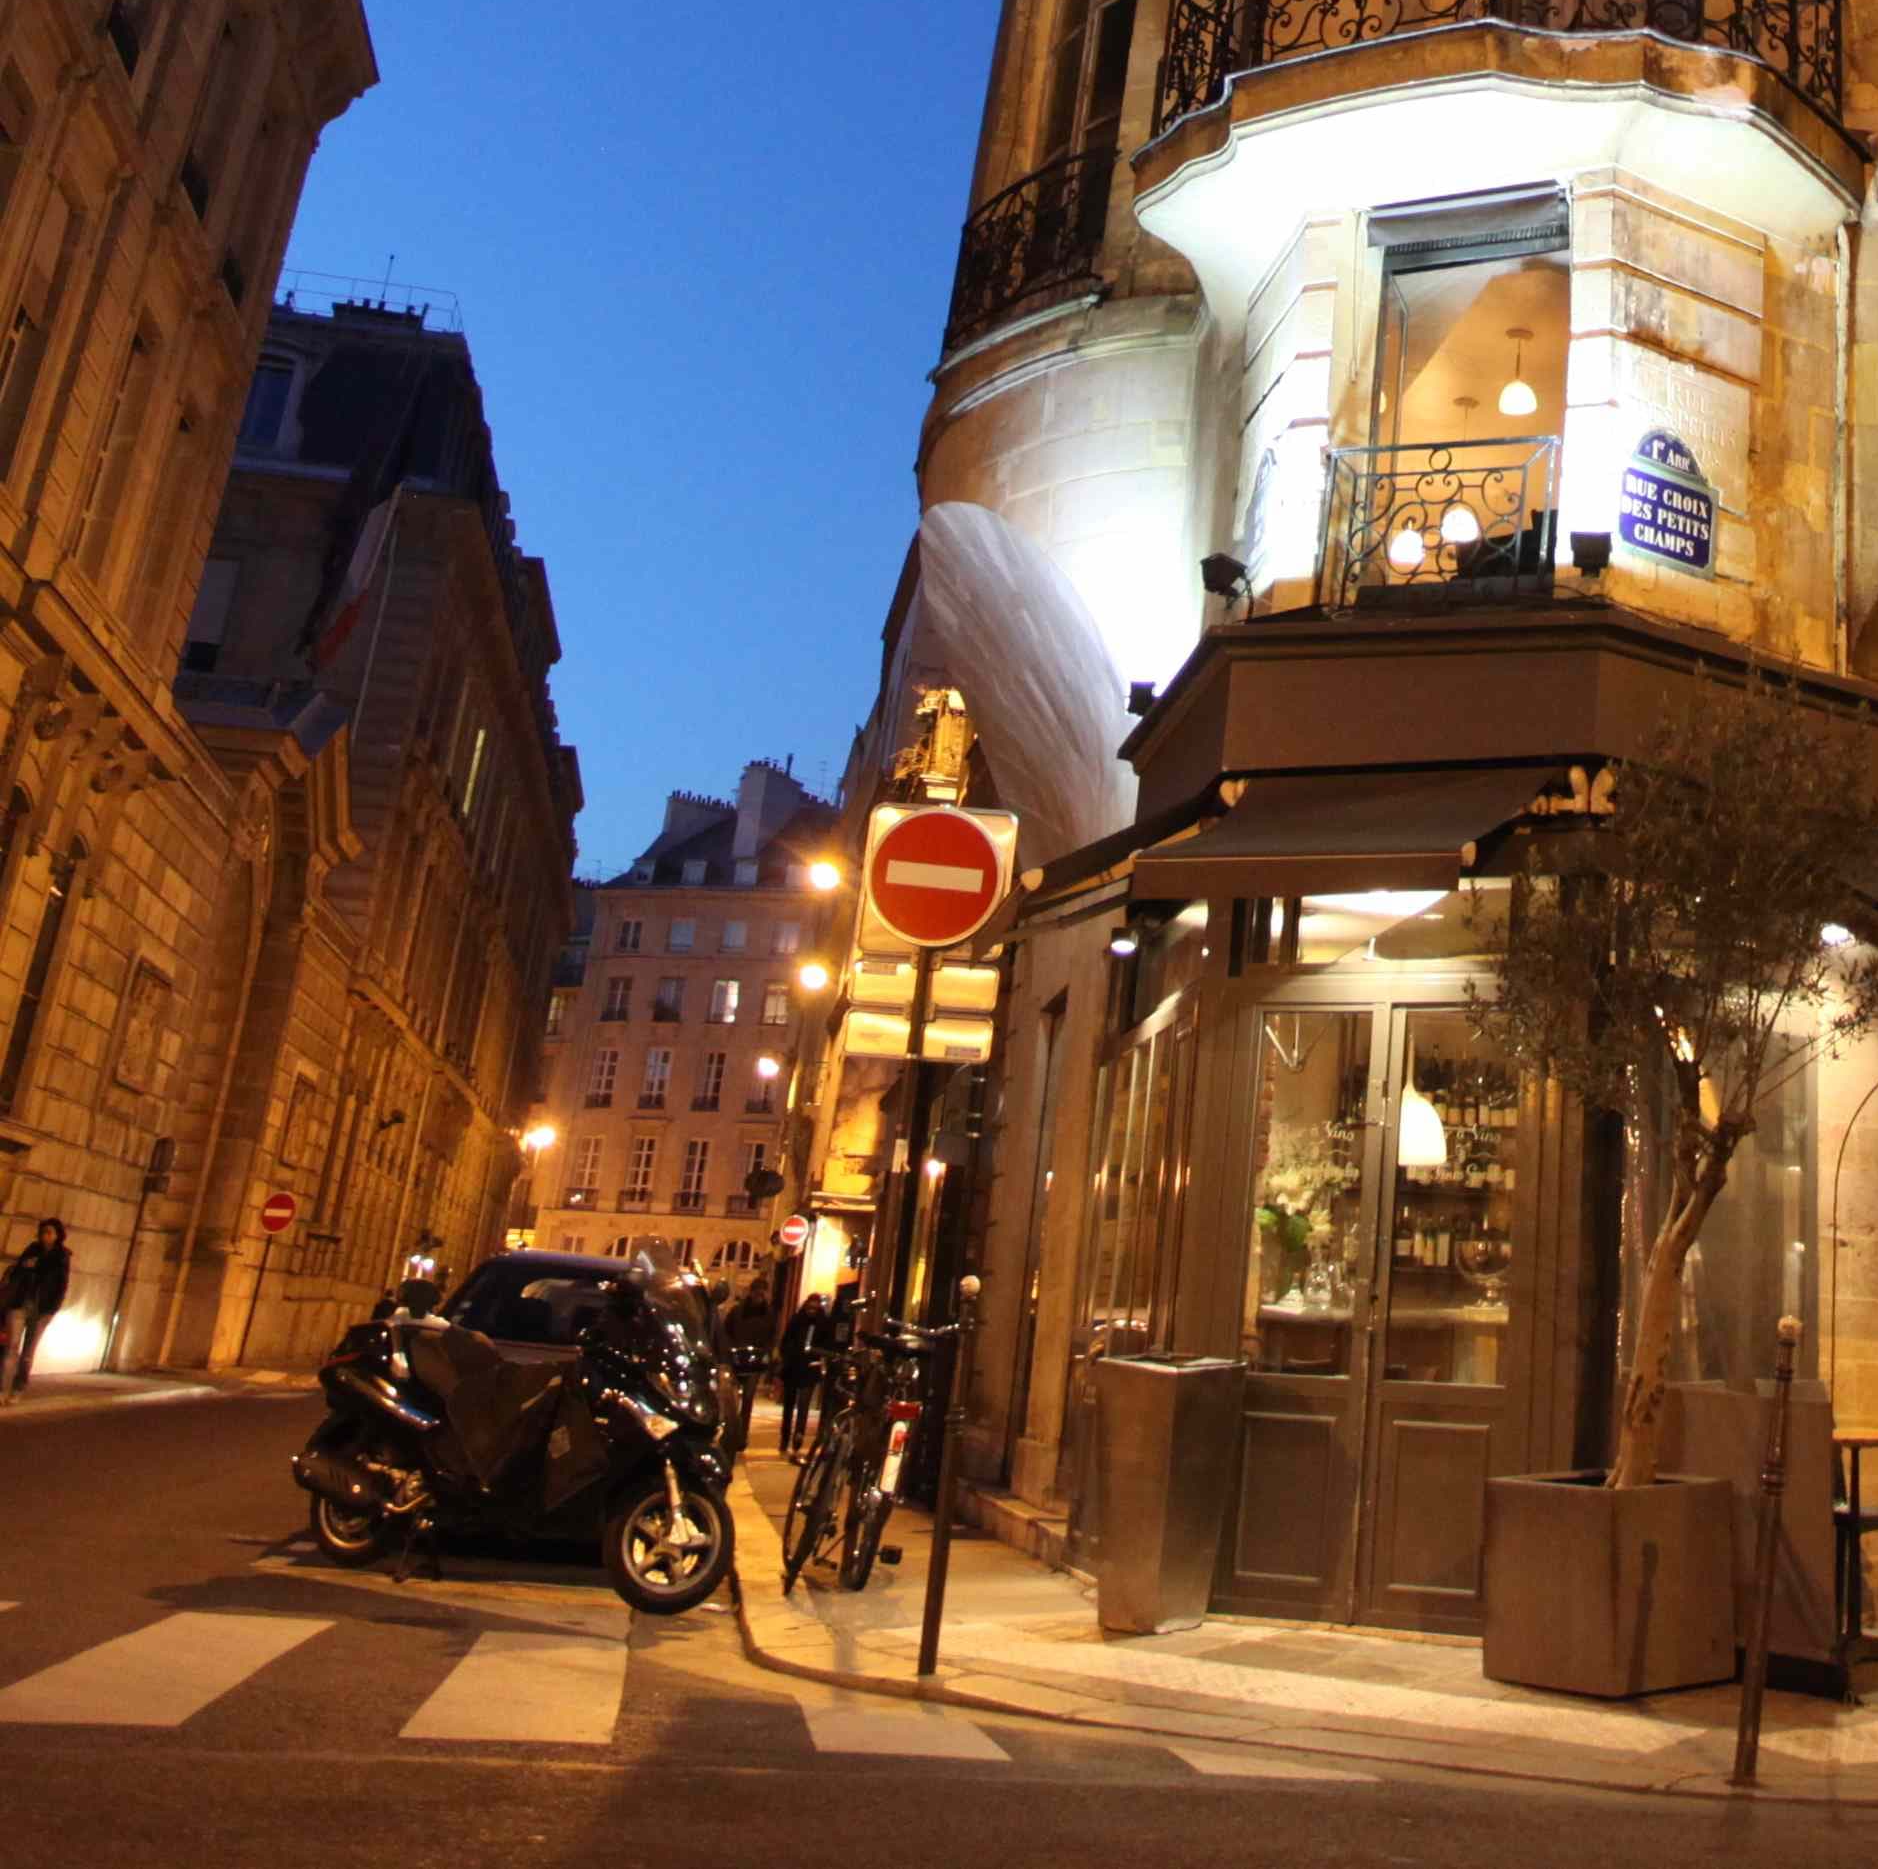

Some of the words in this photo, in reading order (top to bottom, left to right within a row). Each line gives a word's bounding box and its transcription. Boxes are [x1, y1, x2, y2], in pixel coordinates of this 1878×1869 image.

[1621, 495, 1653, 521] DES
[1656, 508, 1710, 540] PETITS
[1625, 474, 1658, 501] RUE
[1662, 489, 1709, 519] CROIX
[1633, 522, 1695, 557] CHAMPS
